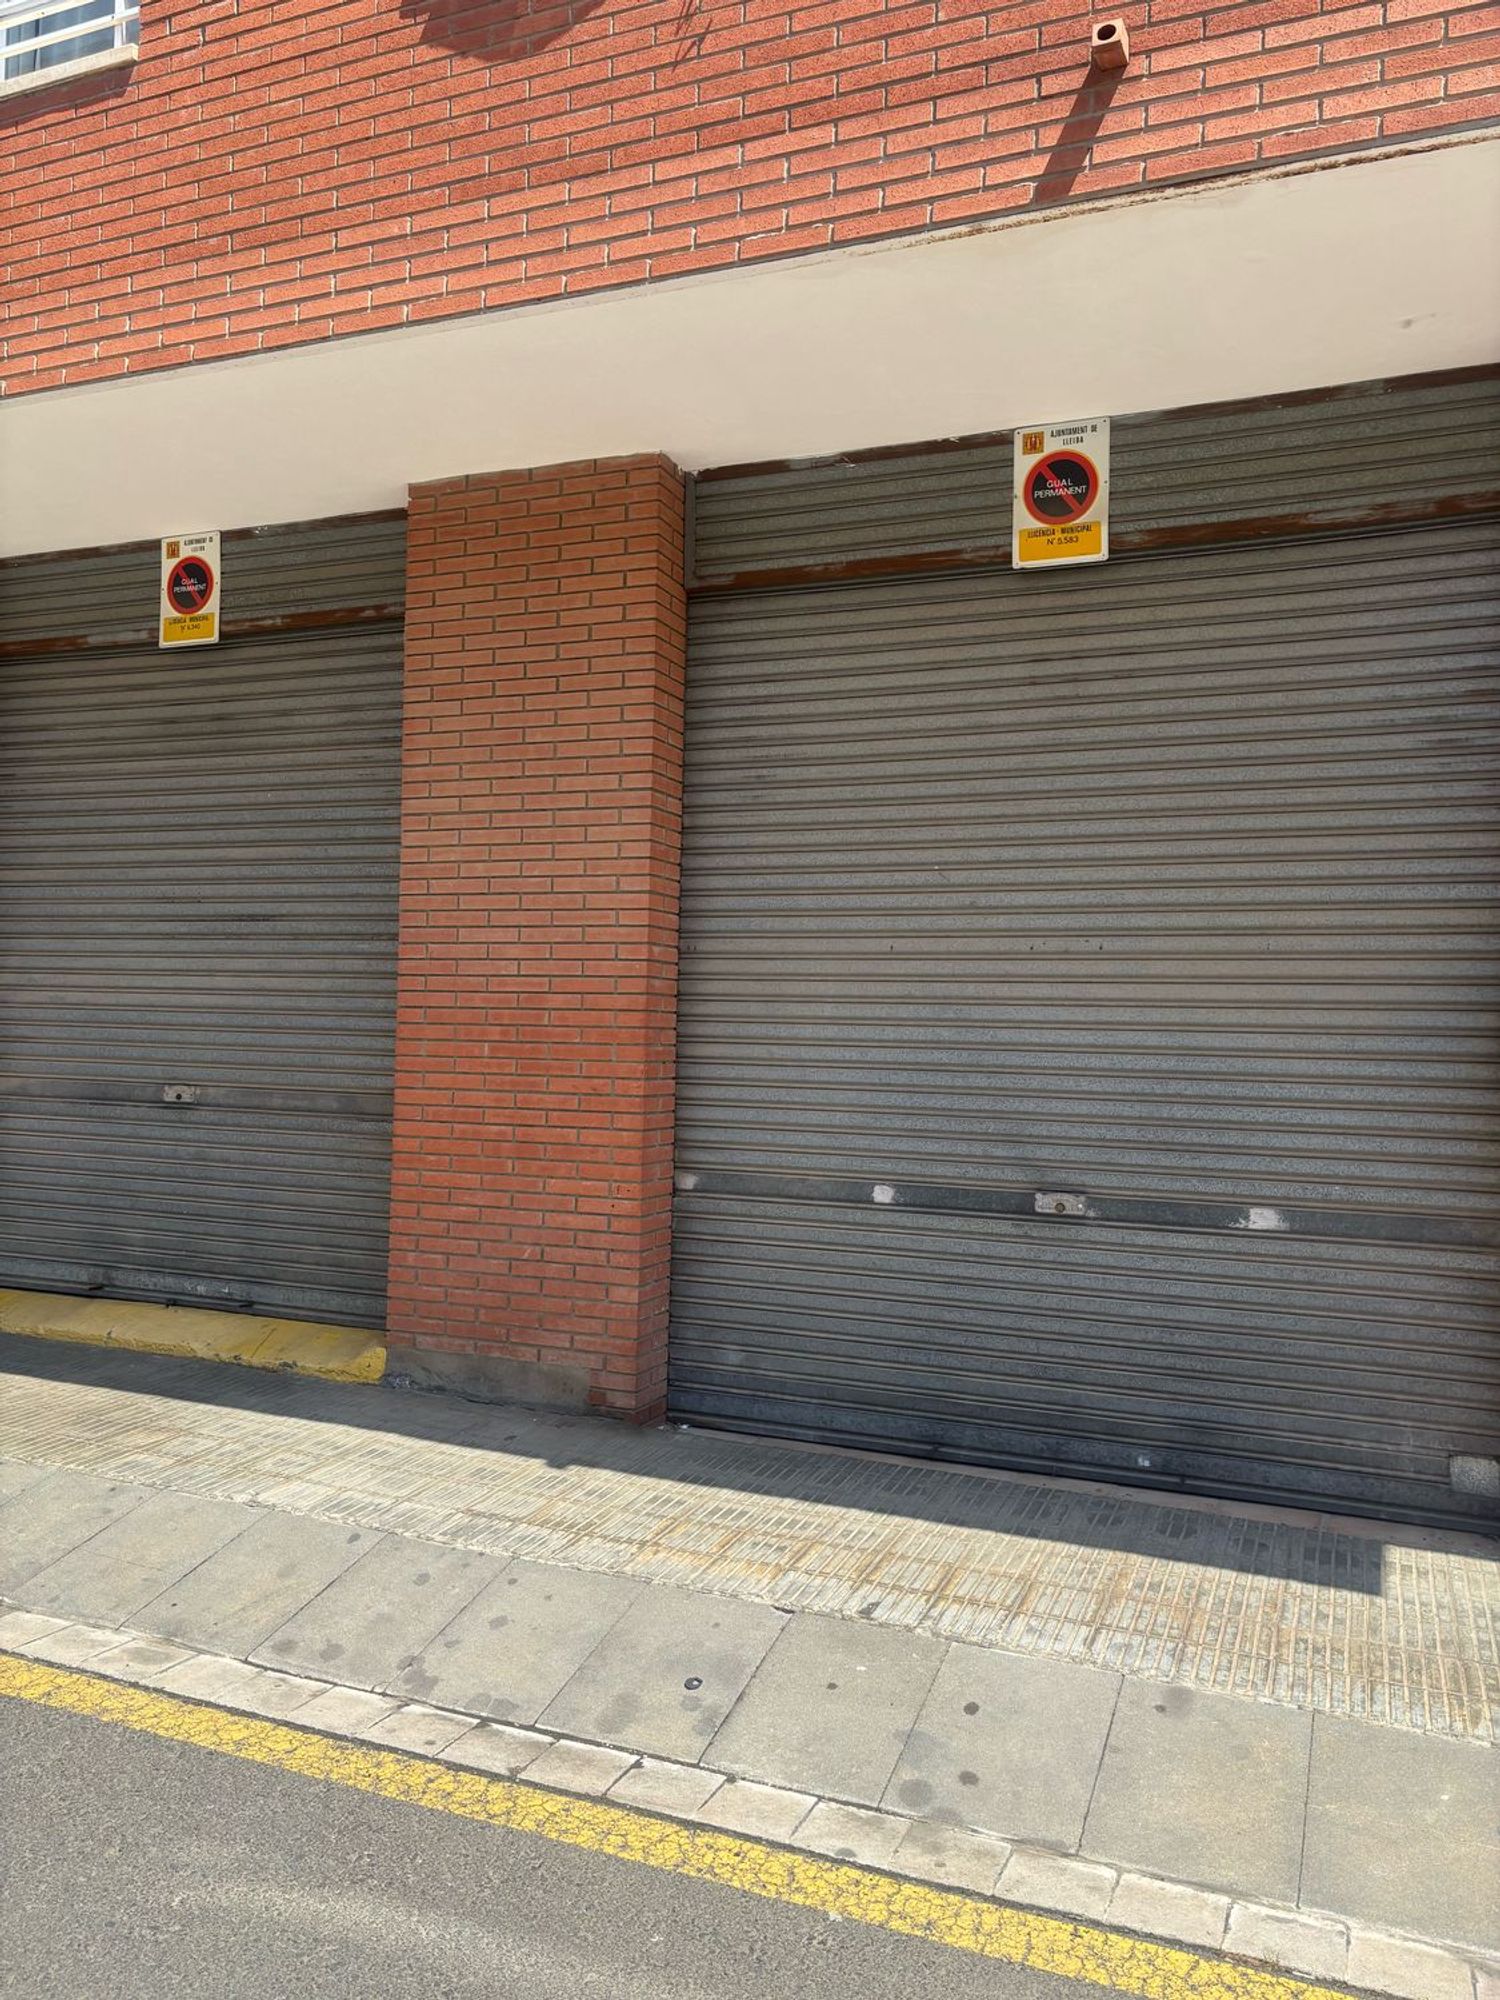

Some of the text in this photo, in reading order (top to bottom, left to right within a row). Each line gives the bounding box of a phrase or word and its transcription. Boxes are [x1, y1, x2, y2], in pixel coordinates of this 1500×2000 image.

[1090, 424, 1098, 433] DE
[1046, 477, 1073, 488] GUAL
[1034, 485, 1088, 499] PERMANENT
